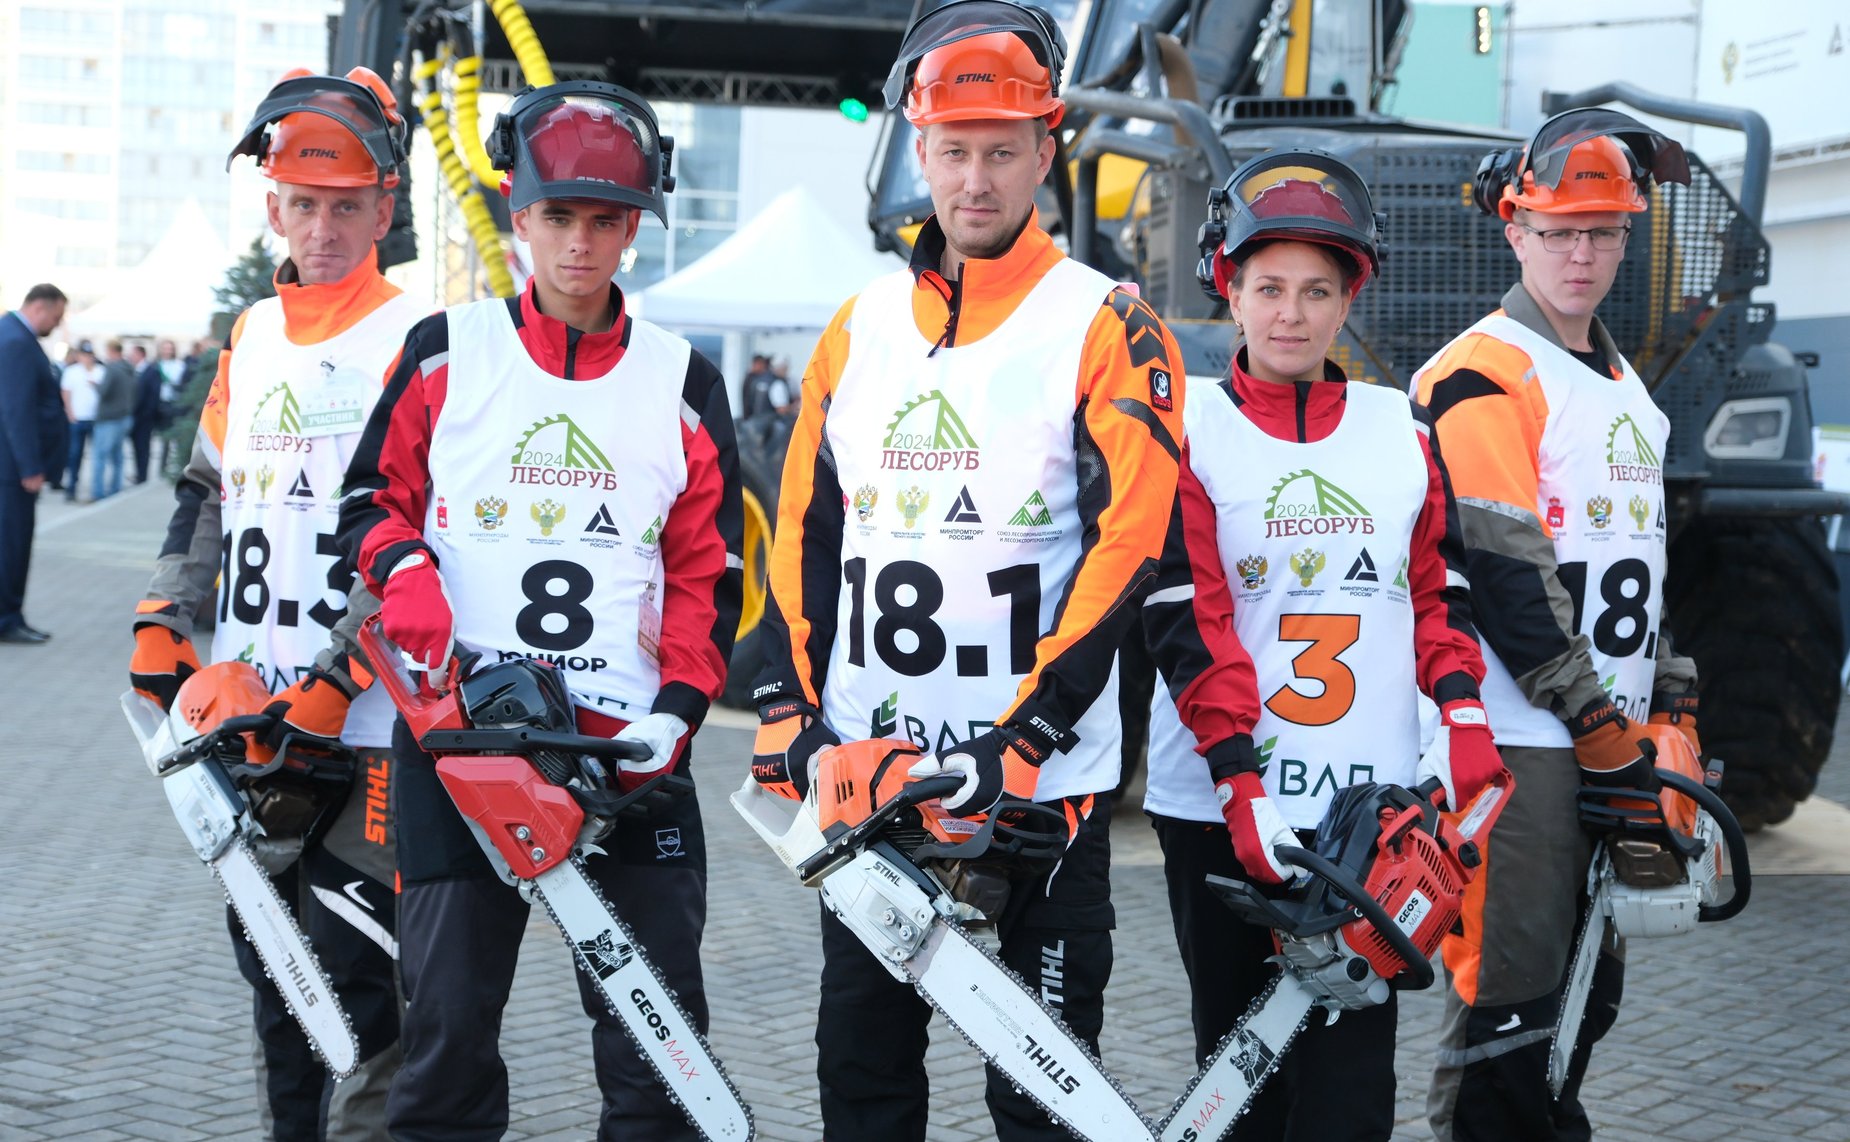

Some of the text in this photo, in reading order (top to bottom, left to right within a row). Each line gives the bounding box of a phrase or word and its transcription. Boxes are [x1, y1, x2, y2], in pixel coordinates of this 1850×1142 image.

[954, 73, 994, 85] STIHL
[298, 148, 339, 160] STIHL
[1574, 170, 1609, 181] STIHL
[892, 432, 933, 450] 2024
[523, 451, 564, 468] 2024
[880, 449, 980, 472] ЛЕСОРУБ
[1614, 450, 1639, 464] 2024
[509, 466, 618, 491] ЛЕСОРУБ
[1276, 503, 1319, 519] 2024
[939, 528, 985, 536] МИНПРОМТОРГ
[1264, 516, 1375, 539] ЛЕСОРУБ
[580, 537, 622, 547] МИНПРОМТОРГ
[515, 559, 595, 652] 8
[843, 556, 1041, 677] 18.1
[1264, 613, 1362, 727] 3
[752, 682, 780, 699] STIHL
[768, 704, 797, 718] STIHL
[1029, 715, 1060, 742] STIHL
[1014, 738, 1039, 760] STIHL
[751, 763, 778, 778] TIHL
[364, 759, 389, 847] STIHL
[872, 860, 901, 888] STIHL
[1398, 897, 1420, 925] GEOS
[1407, 907, 1424, 929] MAX
[600, 950, 620, 967] GEOS
[284, 952, 319, 1008] STIHL
[1040, 939, 1065, 1022] TIHL
[630, 987, 702, 1082] GEOS MAX
[1022, 1033, 1081, 1095] STIHL
[1192, 1087, 1226, 1133] MAX
